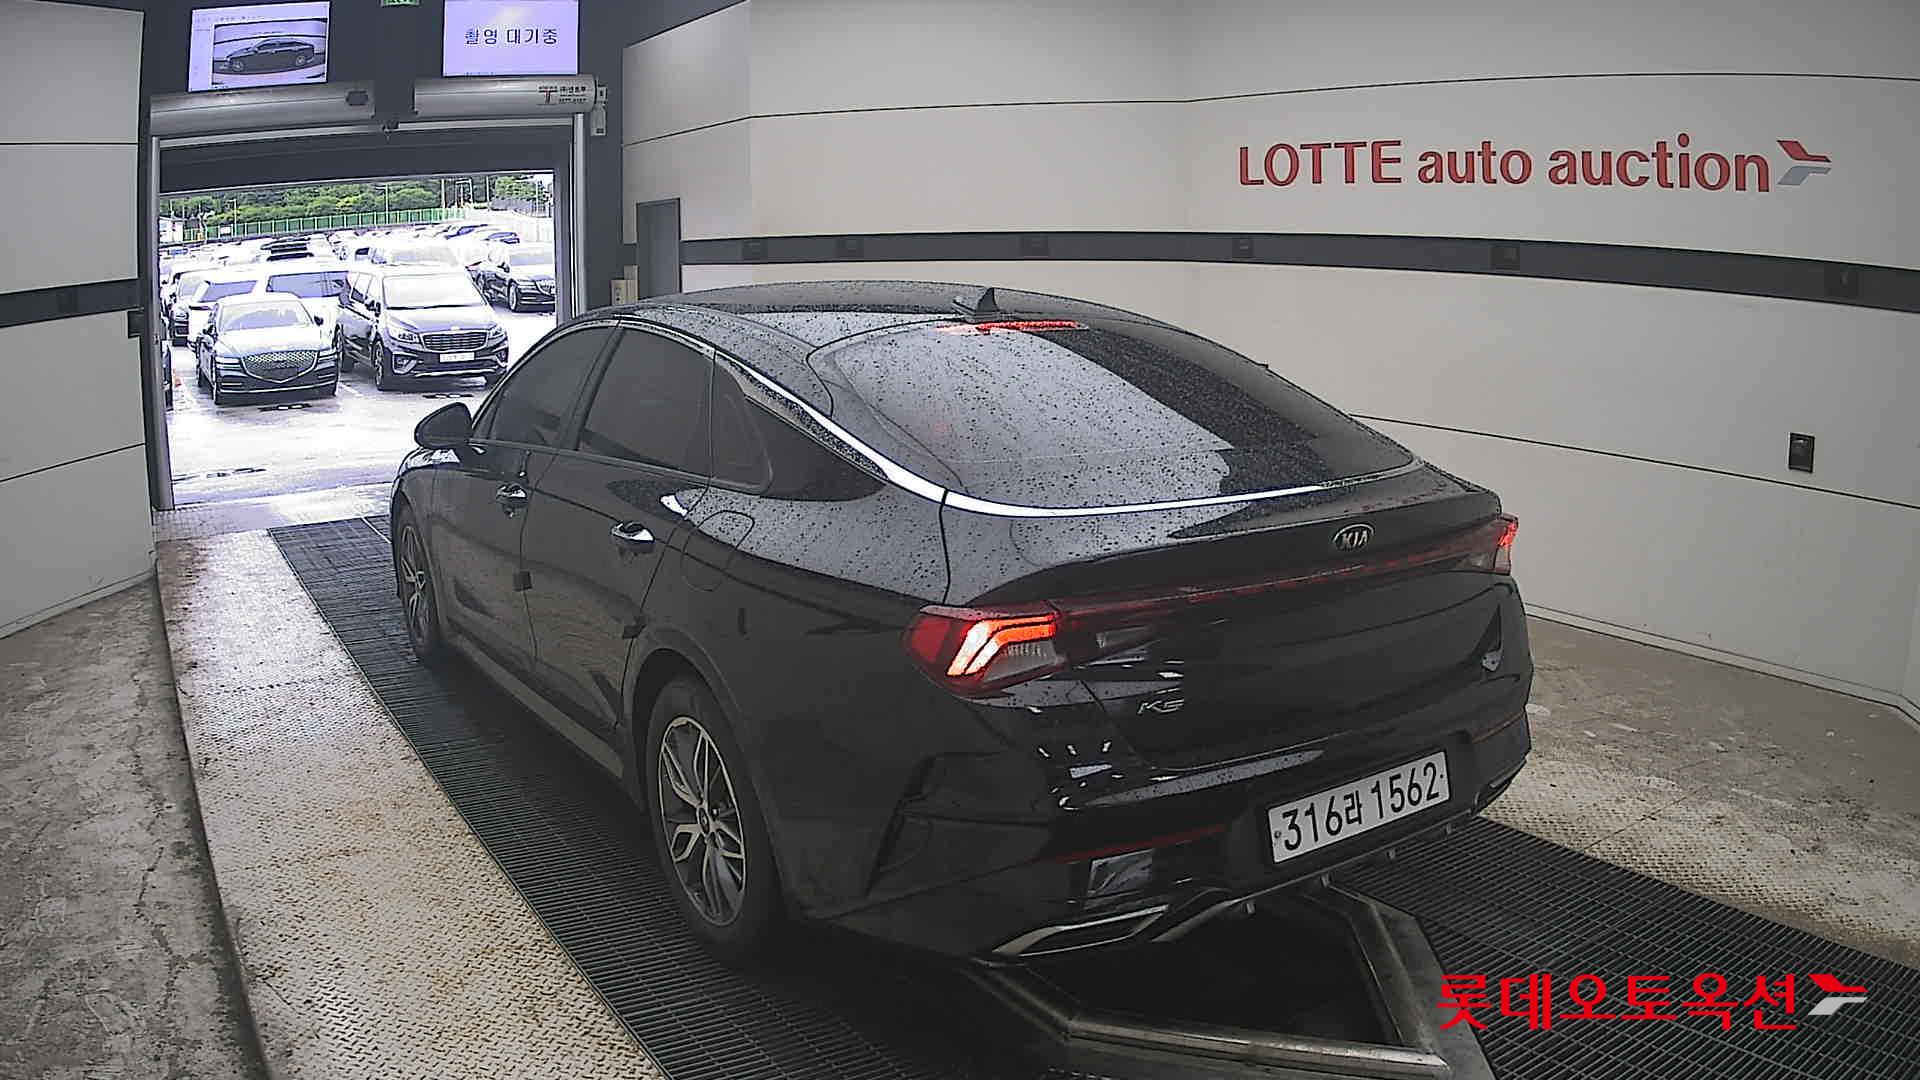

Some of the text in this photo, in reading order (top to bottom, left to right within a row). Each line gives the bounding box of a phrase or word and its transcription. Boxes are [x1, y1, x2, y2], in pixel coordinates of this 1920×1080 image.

[465, 28, 558, 45] 촬영 대기중
[1239, 132, 1771, 193] LOTTE auto auction
[1341, 528, 1369, 547] KIA
[1137, 699, 1185, 714] K5
[1281, 761, 1440, 851] 316라 1562
